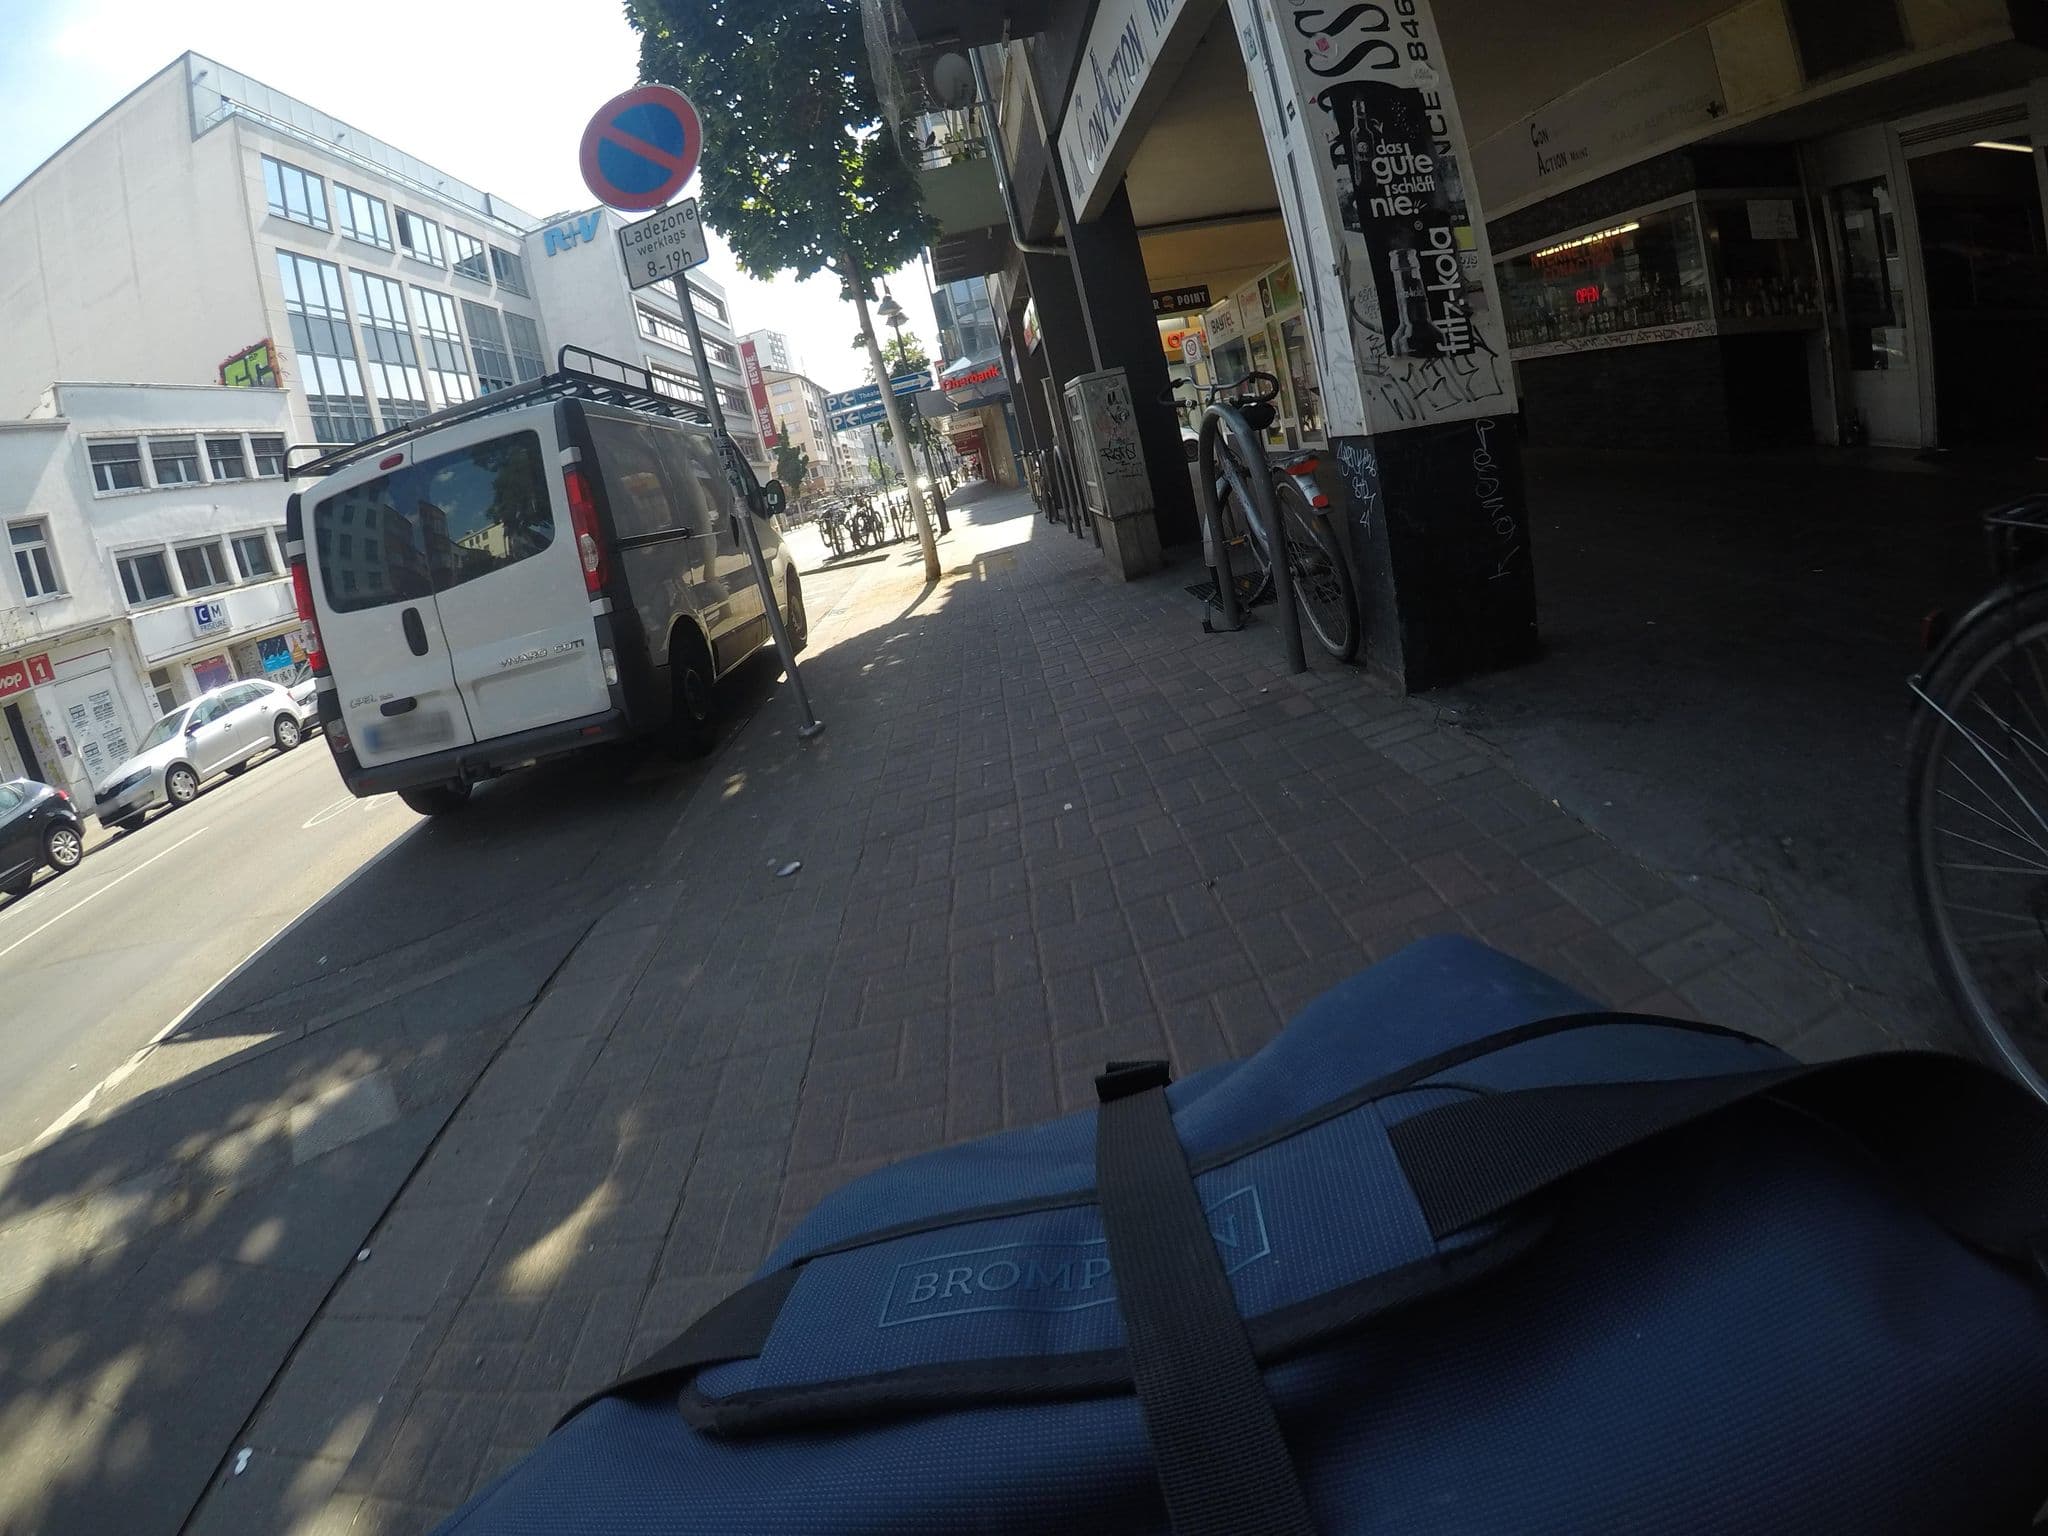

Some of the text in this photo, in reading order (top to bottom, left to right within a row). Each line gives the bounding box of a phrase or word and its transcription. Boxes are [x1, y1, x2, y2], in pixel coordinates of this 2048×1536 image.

[1089, 14, 1145, 127] ACTION
[1375, 138, 1404, 155] das
[1371, 143, 1434, 185] gute
[1536, 151, 1568, 177] ACTION
[1391, 175, 1436, 196] schläft
[623, 206, 695, 247] Ladezone
[636, 228, 686, 256] werktags
[647, 248, 693, 278] 8-19h
[1177, 290, 1206, 307] POINT
[1420, 227, 1472, 354] fritz-kola
[1574, 285, 1601, 305] OPEN
[744, 355, 763, 387] REWE
[826, 396, 838, 411] P
[758, 405, 775, 438] REWE
[831, 416, 843, 431] P
[36, 662, 47, 678] 1
[910, 1213, 1239, 1304] BROMPN
